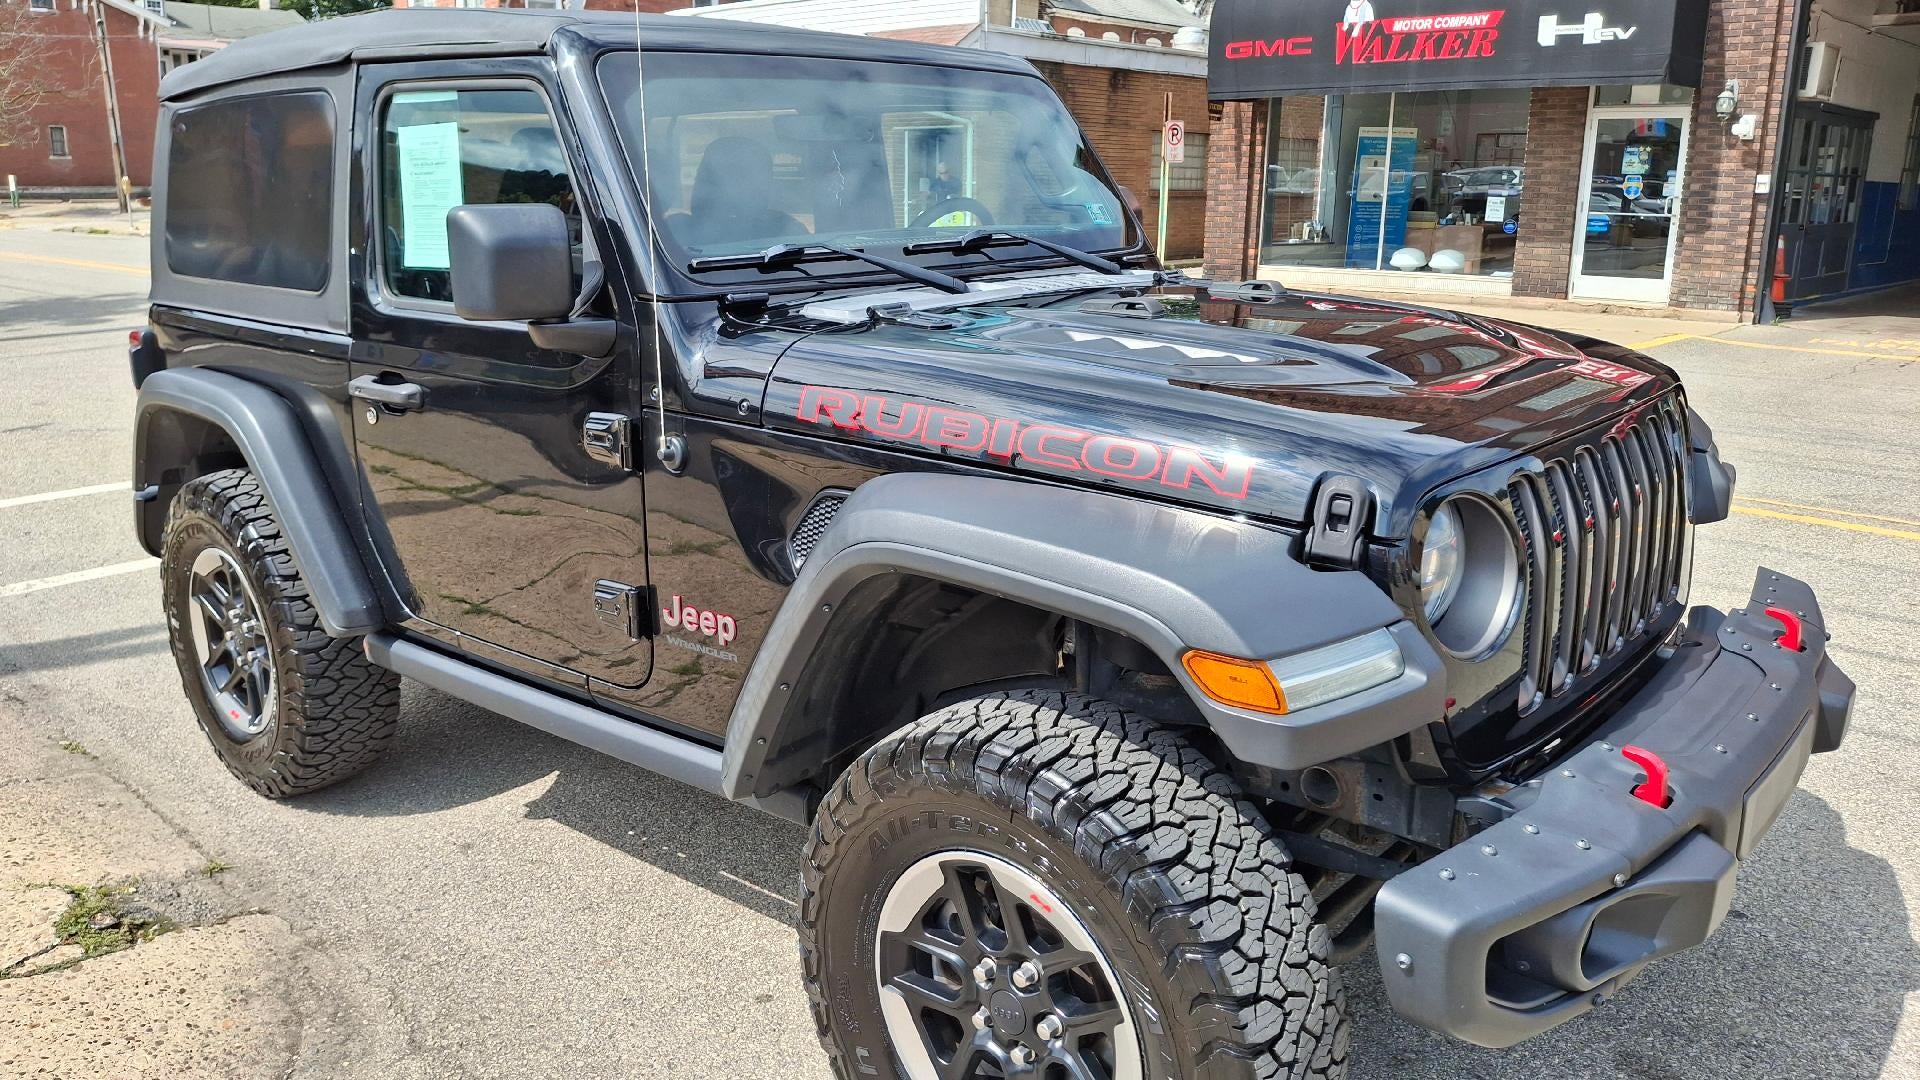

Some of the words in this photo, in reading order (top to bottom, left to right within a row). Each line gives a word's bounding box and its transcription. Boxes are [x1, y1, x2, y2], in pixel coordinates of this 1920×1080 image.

[1393, 18, 1432, 32] MOTOR
[1434, 14, 1489, 29] COMPANY
[1225, 37, 1313, 59] GMC
[1335, 21, 1499, 65] WALKER
[796, 385, 1253, 500] RUBICON
[662, 594, 737, 647] Jeep
[666, 634, 738, 663] WRANGLER
